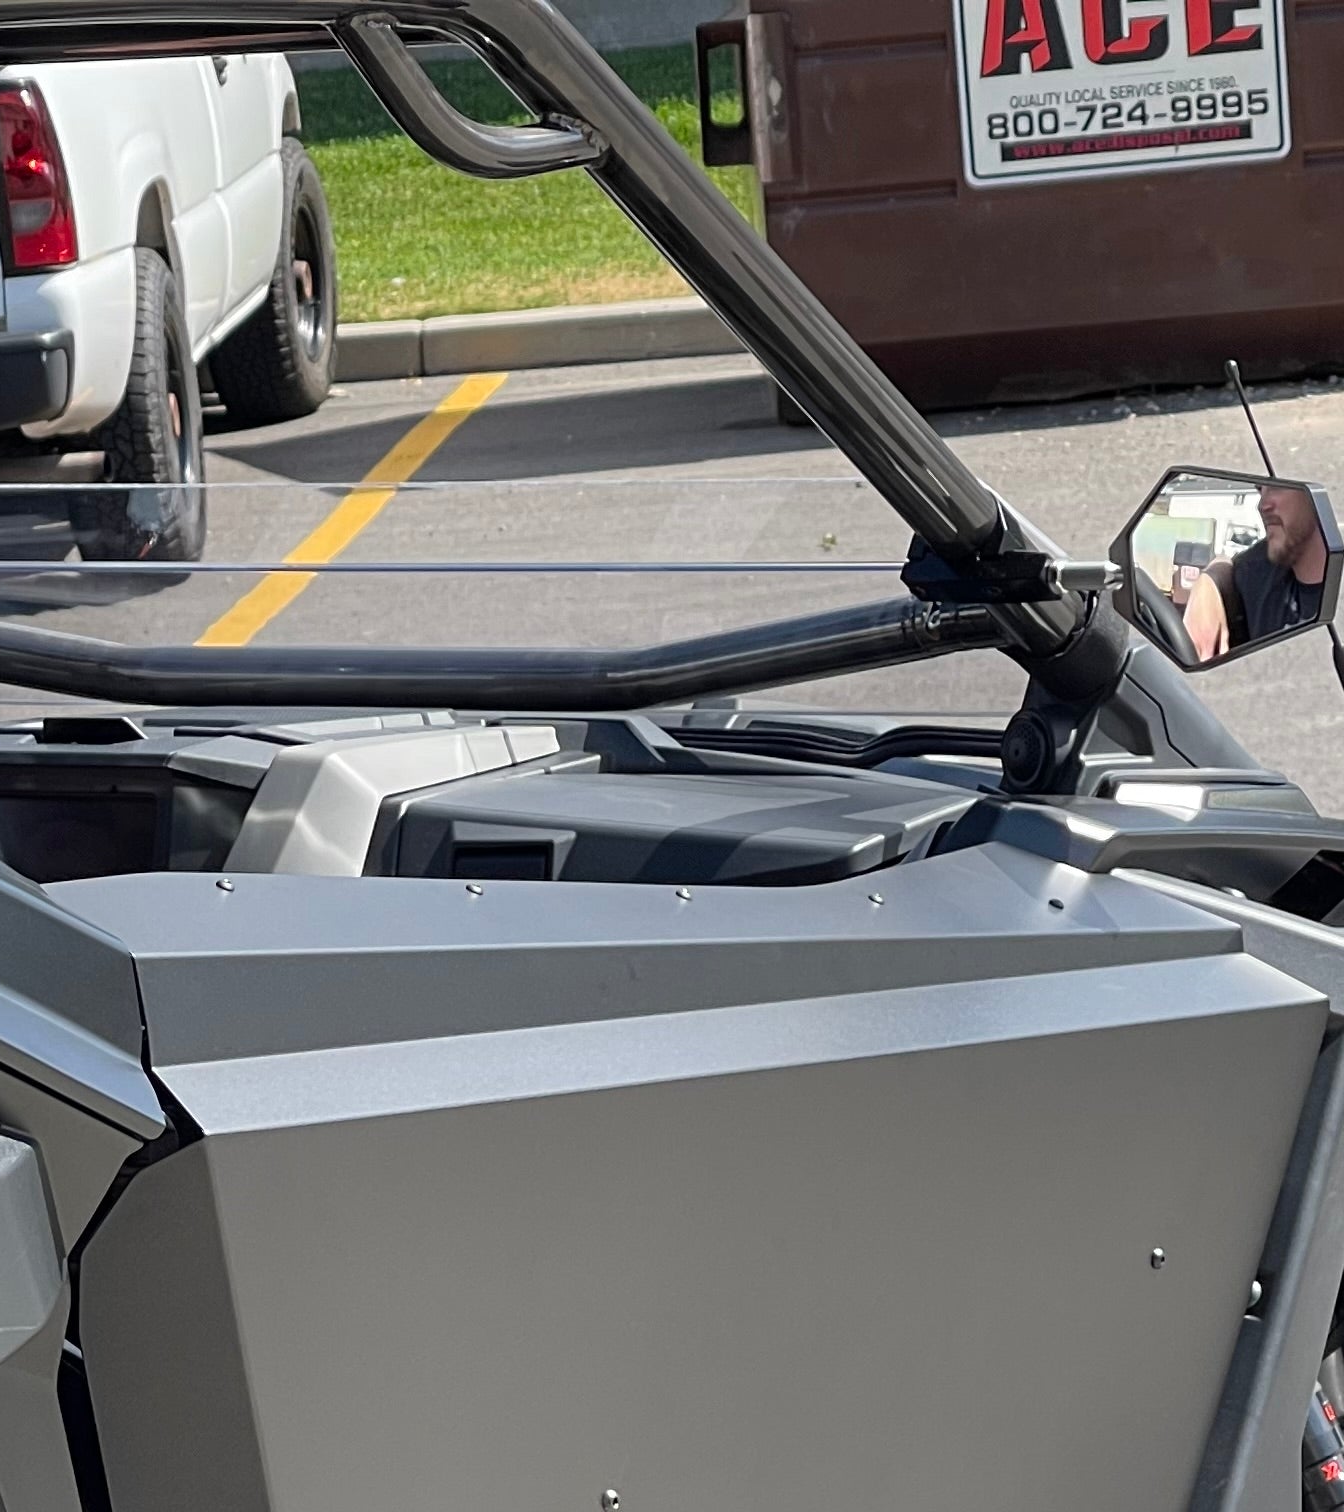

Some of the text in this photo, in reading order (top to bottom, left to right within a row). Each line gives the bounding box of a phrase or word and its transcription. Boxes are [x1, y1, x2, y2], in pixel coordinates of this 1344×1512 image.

[980, 0, 1263, 78] ACE
[987, 88, 1269, 139] 800-724-9995
[1009, 91, 1062, 109] QUALITY
[1065, 88, 1106, 104] LOCAL
[1109, 81, 1164, 100] SERVICE
[1167, 77, 1206, 94] SINCE
